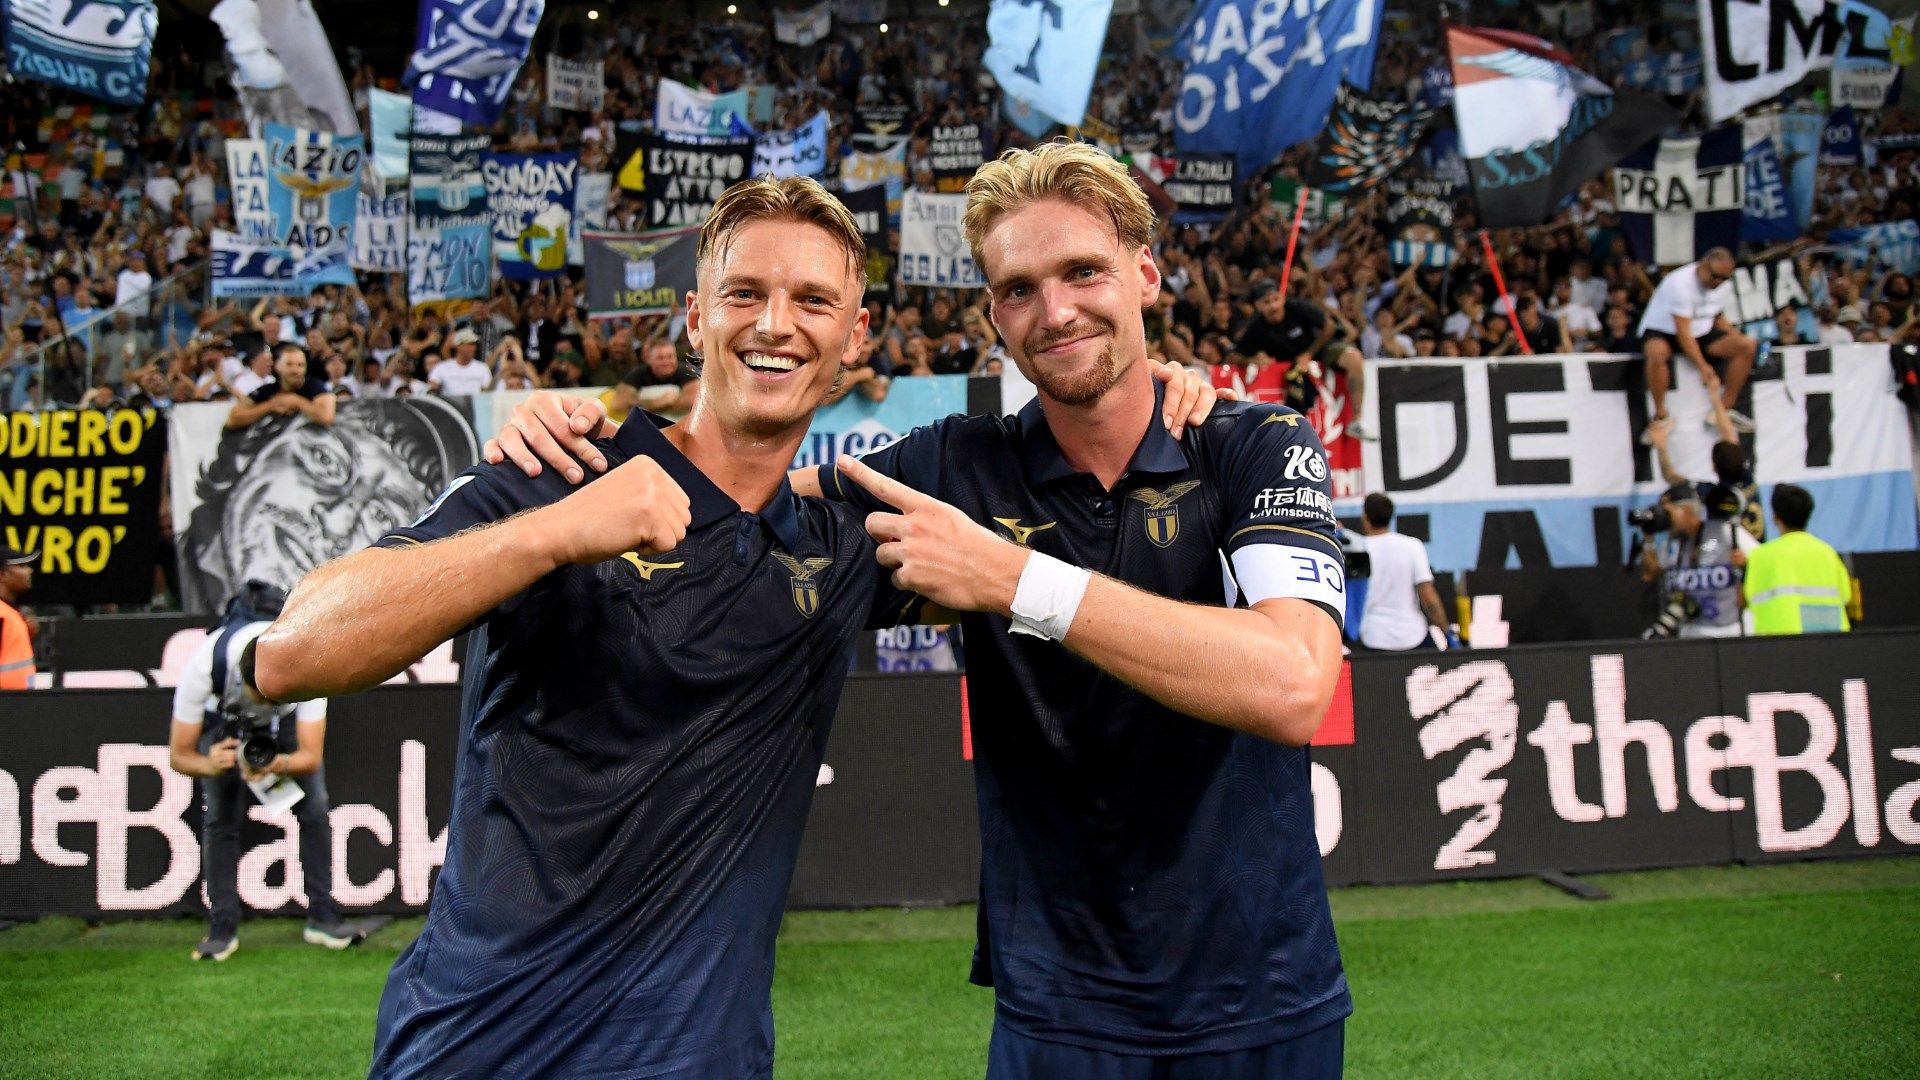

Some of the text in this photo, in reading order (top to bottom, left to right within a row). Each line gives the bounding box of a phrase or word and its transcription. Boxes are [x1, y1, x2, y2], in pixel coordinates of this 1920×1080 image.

[482, 158, 578, 196] SUNDAY
[650, 148, 745, 180] ESTREMO
[664, 174, 726, 201] ATTO
[1620, 172, 1742, 213] PRATI
[0, 408, 157, 458] DIERO'
